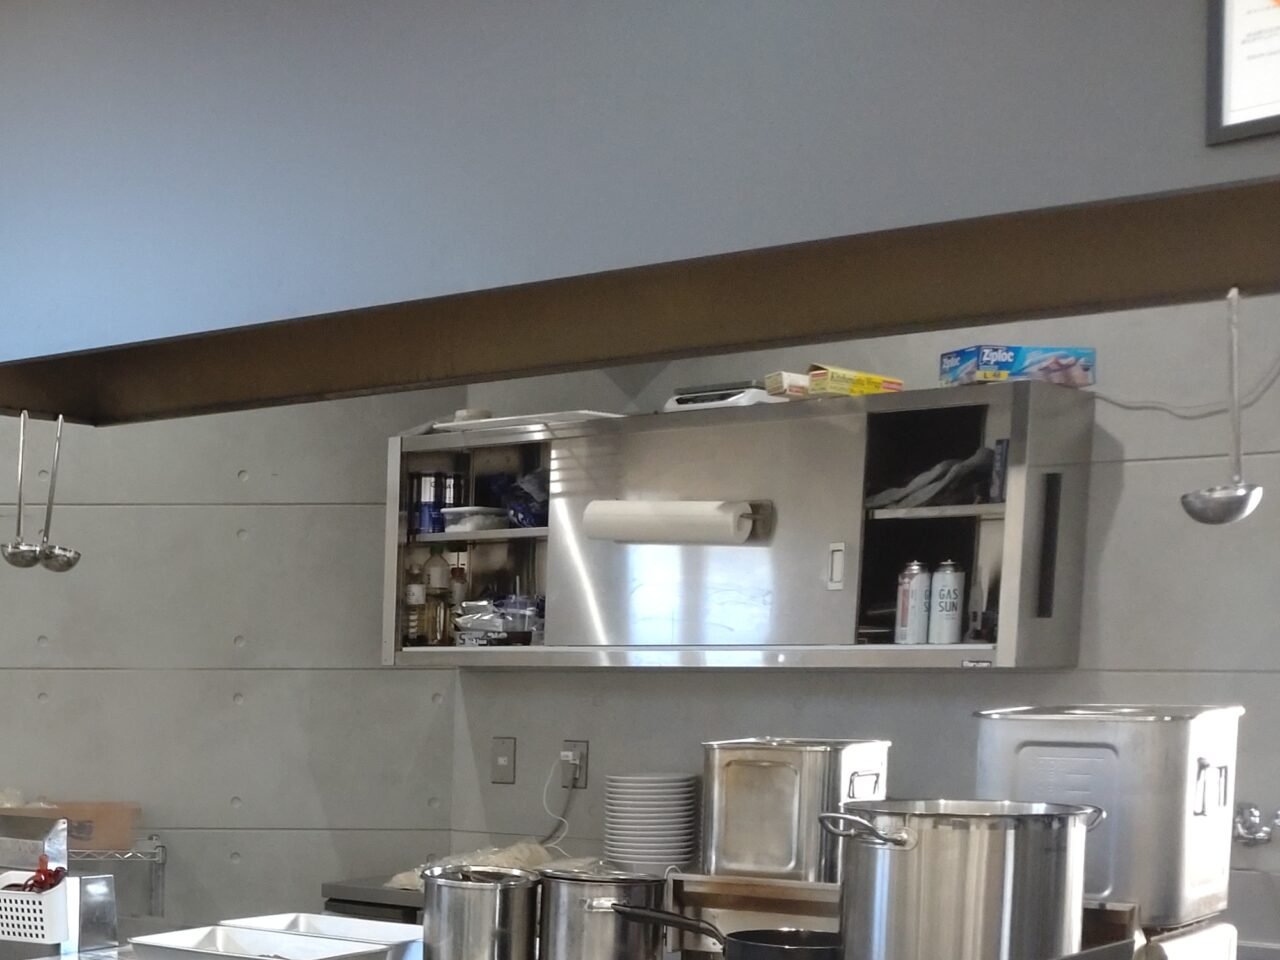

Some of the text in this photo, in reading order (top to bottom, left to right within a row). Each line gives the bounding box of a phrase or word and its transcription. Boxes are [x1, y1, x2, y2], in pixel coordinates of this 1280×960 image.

[982, 348, 1015, 365] Ziploc
[938, 588, 959, 600] GAS
[938, 601, 959, 613] SUN
